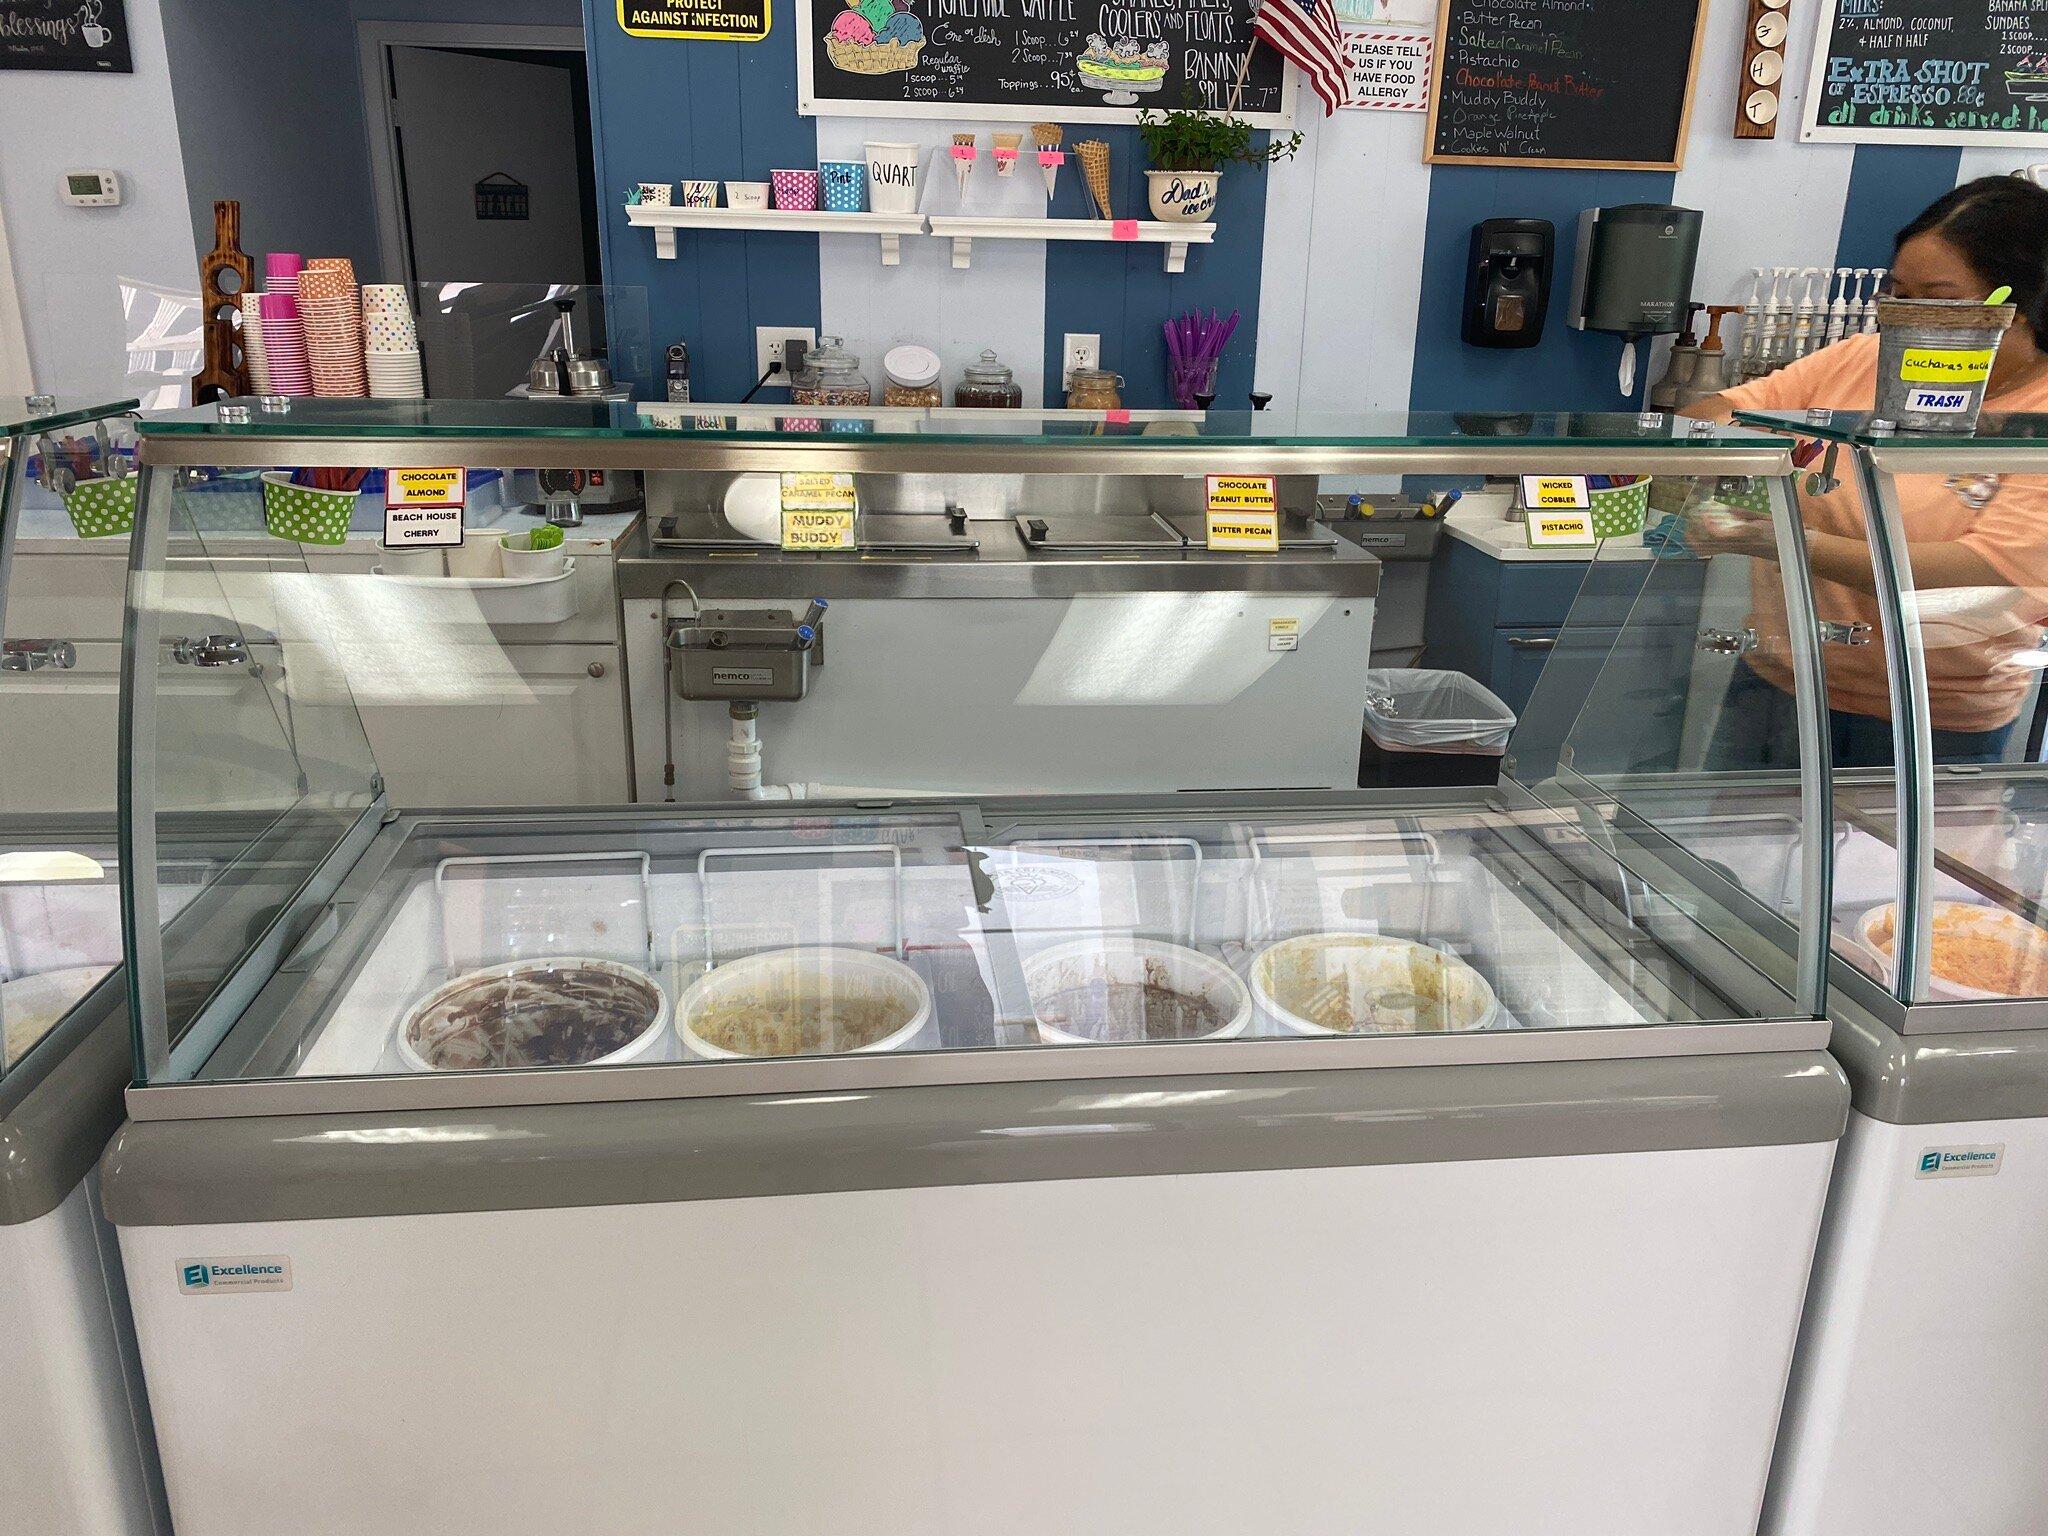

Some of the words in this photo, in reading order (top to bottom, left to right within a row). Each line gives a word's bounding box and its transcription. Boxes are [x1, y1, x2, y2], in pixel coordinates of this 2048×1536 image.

[667, 0, 722, 10] PROTECT
[1989, 0, 2028, 12] BANANA
[2030, 0, 2048, 12] SPLI
[632, 10, 688, 25] AGAINST
[692, 13, 758, 28] INFECTION
[1099, 4, 1163, 42] COOLERS,
[1164, 11, 1184, 30] AND
[1463, 11, 1504, 25] Butter
[1508, 13, 1542, 29] Pecan
[1864, 17, 1905, 30] ALMOND,
[1911, 17, 1954, 32] COCONUT,
[1985, 15, 2030, 30] SUNDAES
[932, 22, 964, 46] Cone
[974, 26, 1001, 46] dish
[1458, 26, 1504, 50] Salted
[1870, 35, 1894, 48] HALF
[1896, 35, 1902, 47] N
[1906, 34, 1929, 47] HALF
[2001, 31, 2007, 40] 1
[1011, 48, 1020, 63] 2
[1351, 44, 1393, 55] PLEASE
[1396, 46, 1422, 57] TELL
[2000, 44, 2006, 54] 2
[922, 51, 962, 70] Regular
[1185, 49, 1250, 81] BANANA
[1359, 59, 1373, 68] US
[1376, 60, 1386, 69] IF
[1389, 60, 1413, 70] YOU
[1459, 50, 1520, 68] Pistachio
[941, 63, 970, 74] waffle
[1752, 62, 1764, 77] H
[1914, 58, 1990, 85] SHOT
[1353, 72, 1381, 83] HAVE
[1385, 74, 1415, 84] FOOD
[903, 86, 911, 98] 2
[1358, 86, 1408, 98] ALLERGY
[1452, 90, 1500, 108] Muddy
[1503, 90, 1546, 108] Buddy
[1851, 83, 1951, 106] ESPRESSO
[1453, 107, 1501, 126] Orange
[1749, 102, 1762, 118] T
[1869, 103, 1935, 127] drinks
[1454, 127, 1492, 142] Maple
[1495, 125, 1540, 140] Walnut
[1451, 139, 1489, 154] Cookies
[830, 171, 852, 184] Pint
[872, 161, 917, 187] QUART
[1162, 177, 1210, 204] Dad's
[1917, 394, 1964, 407] TRASH
[401, 473, 457, 481] CHOCOLATE
[393, 513, 423, 521] BEACH
[793, 515, 844, 526] MUDDY
[404, 529, 439, 538] CHERRY
[1212, 526, 1242, 534] BUTTER
[1542, 523, 1584, 531] PISTACHIO
[791, 532, 838, 543] BUDDY
[714, 672, 750, 680] nemco
[1944, 1152, 1996, 1162] Excellence
[212, 1264, 282, 1276] Excellence
